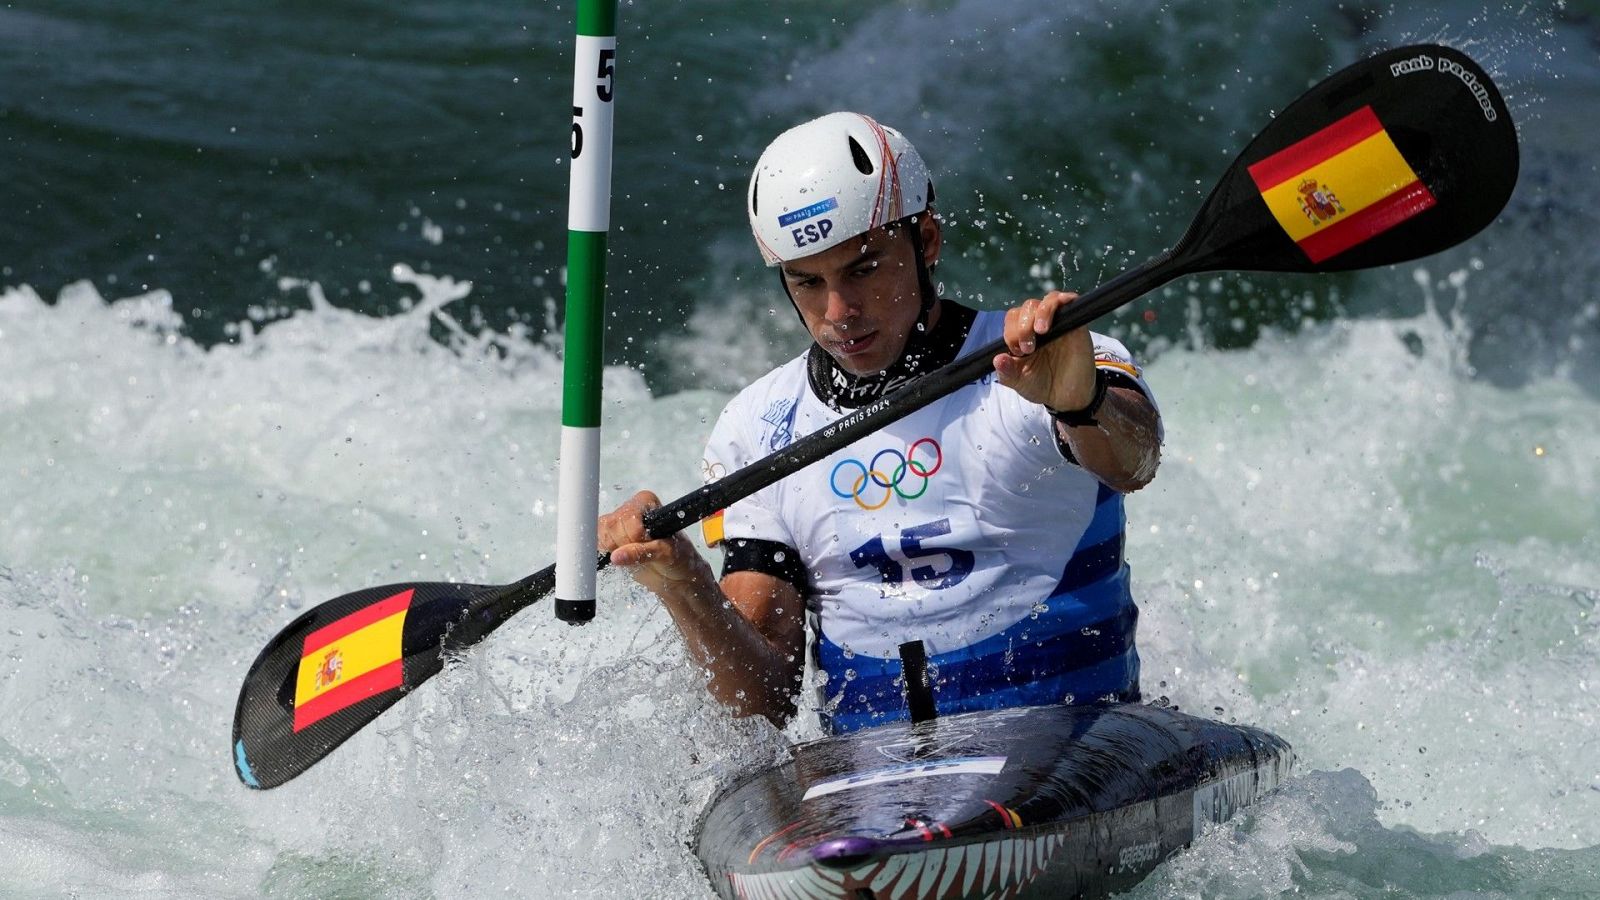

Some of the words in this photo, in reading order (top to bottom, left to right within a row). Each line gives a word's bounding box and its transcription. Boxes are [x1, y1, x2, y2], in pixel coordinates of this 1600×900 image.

[596, 49, 616, 103] 5
[1389, 55, 1435, 78] raab
[1437, 57, 1498, 123] paddles
[792, 218, 833, 249] ESP
[838, 411, 865, 432] PARIS
[865, 399, 891, 418] 2024
[848, 517, 976, 600] 15
